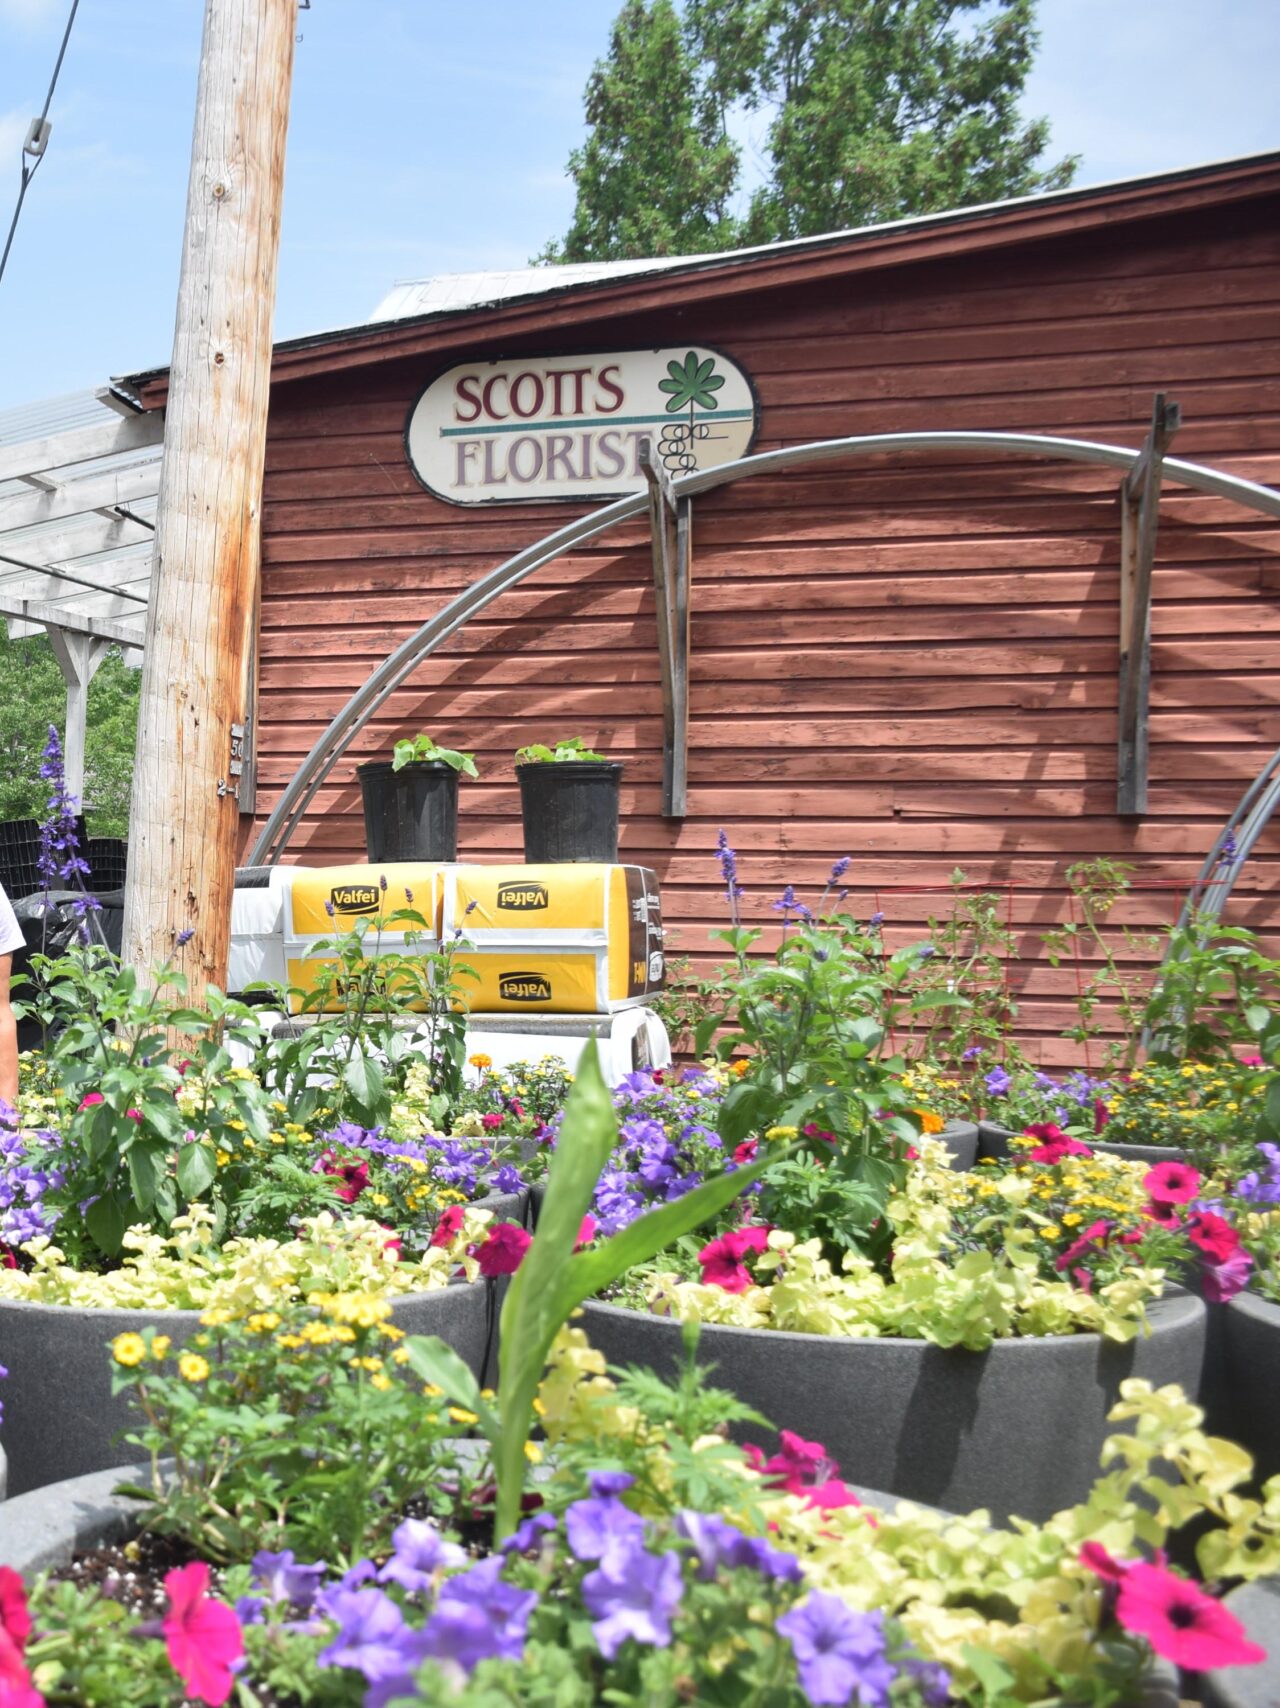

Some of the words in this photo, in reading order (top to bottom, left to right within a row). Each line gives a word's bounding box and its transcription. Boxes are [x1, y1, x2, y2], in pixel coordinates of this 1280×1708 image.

[455, 365, 625, 422] SCOTTS
[454, 430, 654, 487] FLORIST
[334, 889, 376, 904] Valfei
[501, 891, 545, 906] Valfei
[503, 983, 548, 998] Valfei
